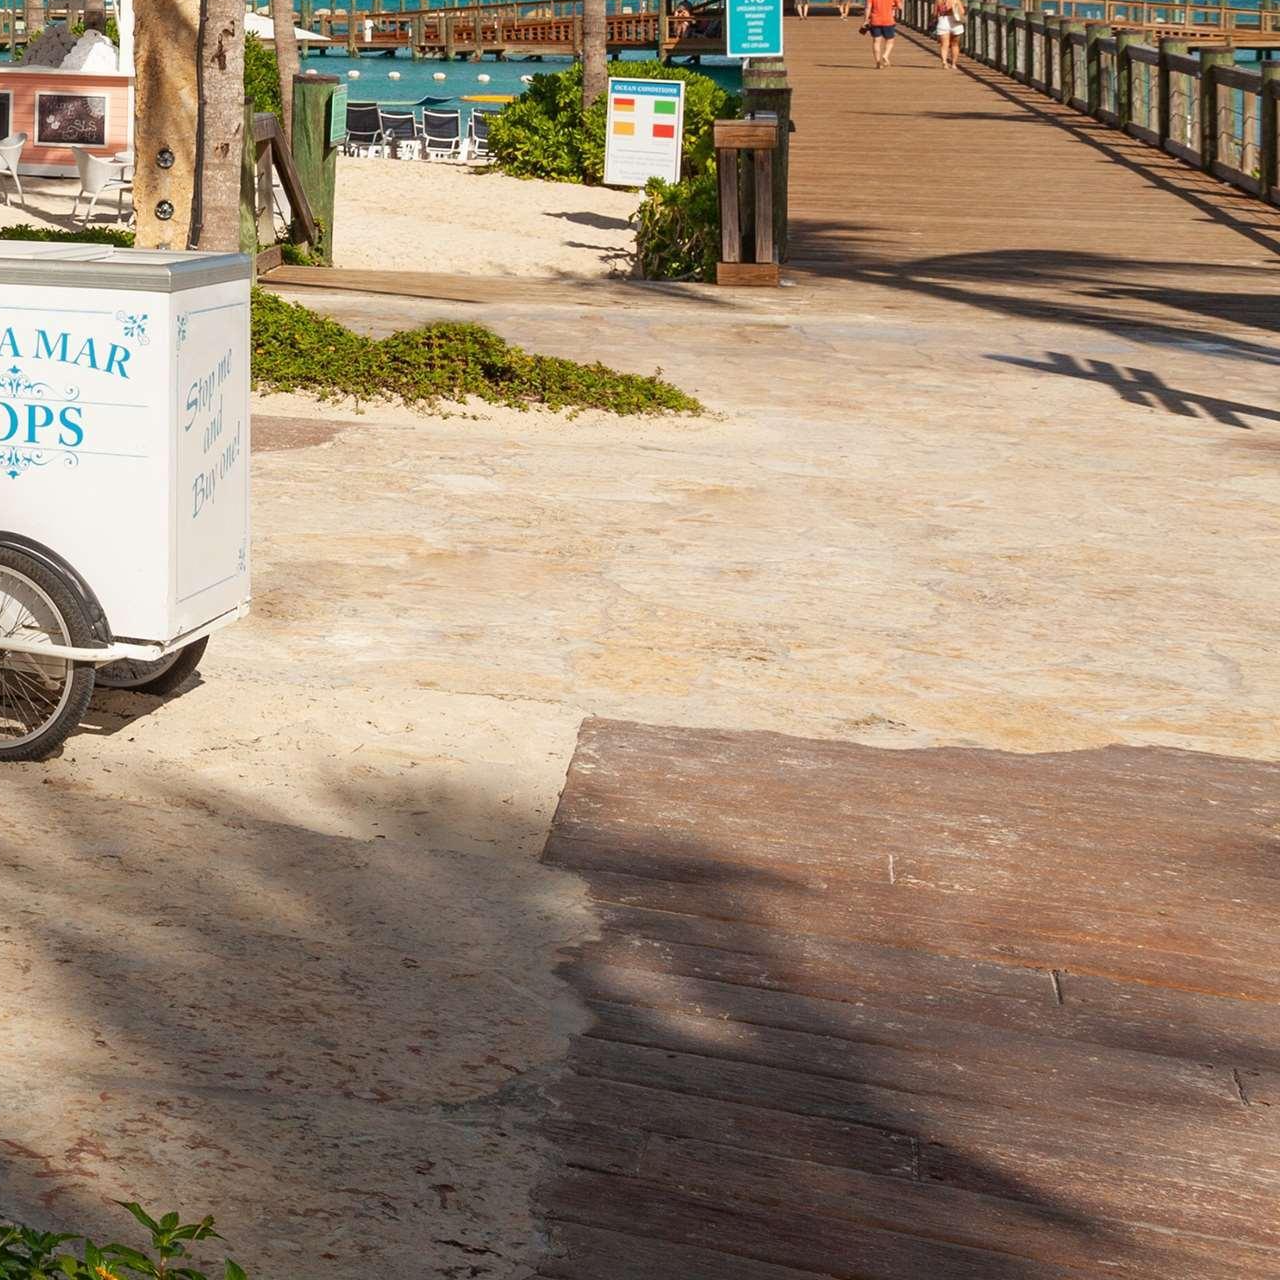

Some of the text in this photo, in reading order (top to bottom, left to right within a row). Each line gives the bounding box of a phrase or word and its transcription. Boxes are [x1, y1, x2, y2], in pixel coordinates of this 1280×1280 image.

[32, 328, 131, 380] MAR
[184, 348, 232, 433] Stop me
[203, 393, 223, 455] and
[192, 420, 241, 519] Buy one!
